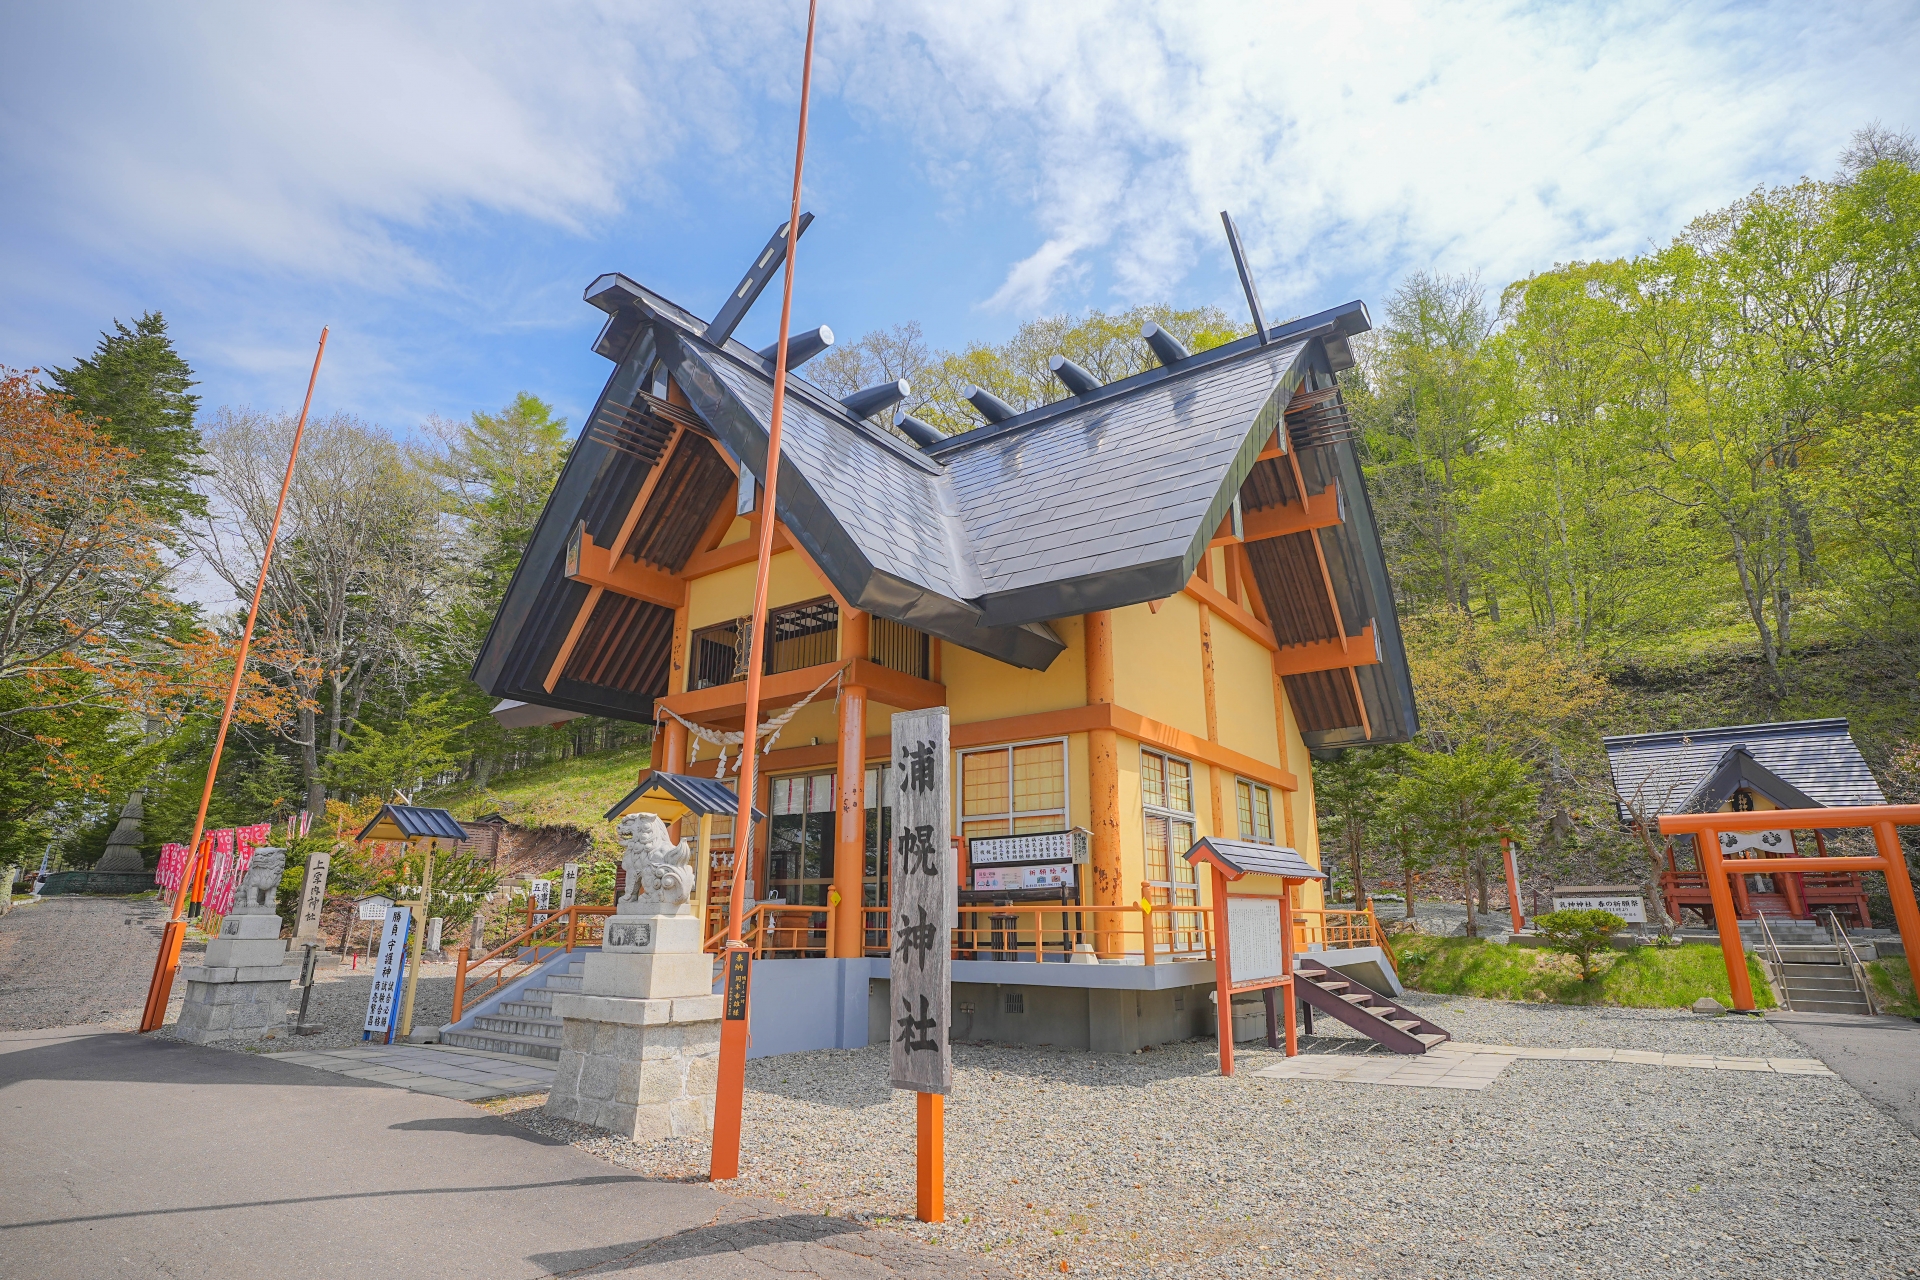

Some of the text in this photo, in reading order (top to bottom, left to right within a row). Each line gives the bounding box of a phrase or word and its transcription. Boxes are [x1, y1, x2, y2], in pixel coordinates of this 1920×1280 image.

[565, 870, 576, 899] 社日
[1029, 866, 1068, 876] 祈願絵馬
[896, 740, 939, 1055] 浦幌神社
[1597, 900, 1639, 908] 春の祈願祭
[382, 911, 402, 978] 勝負守護神
[374, 981, 388, 1026] 試験合格
[380, 981, 395, 1027] 試合必勝
